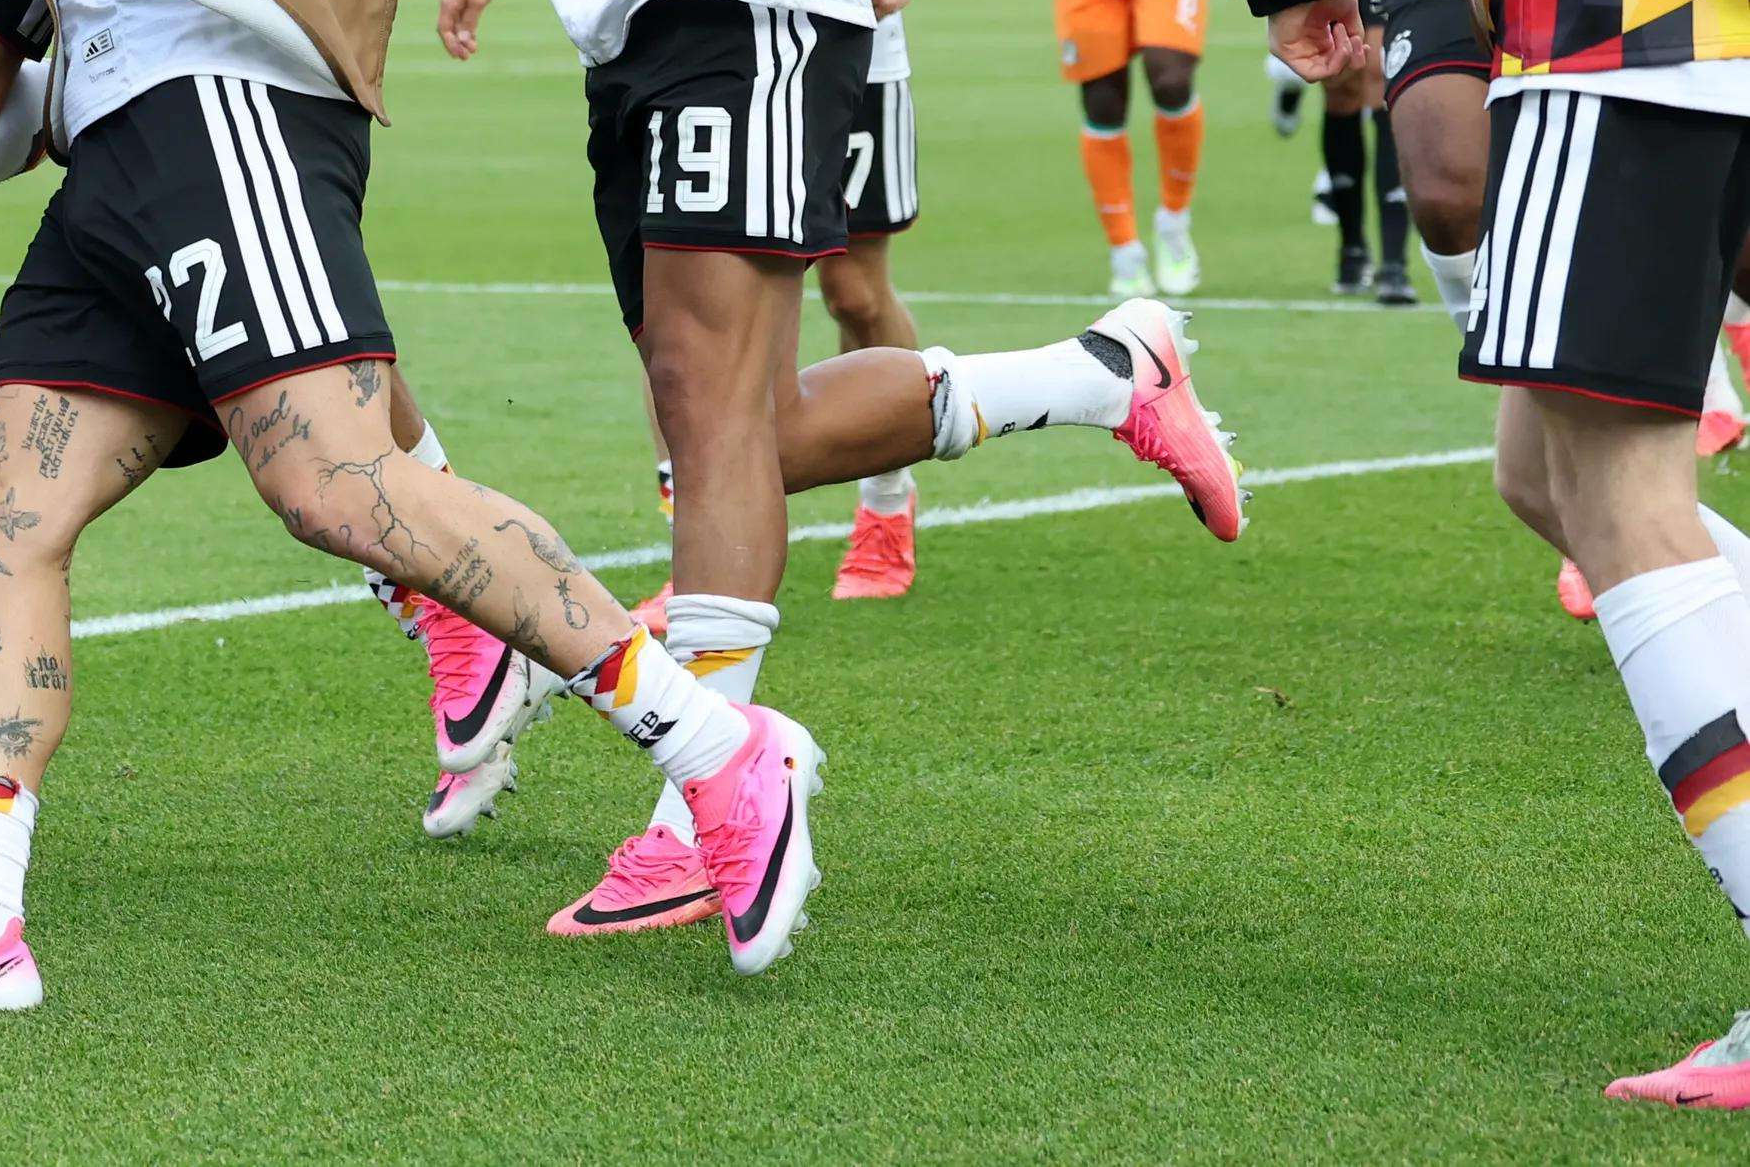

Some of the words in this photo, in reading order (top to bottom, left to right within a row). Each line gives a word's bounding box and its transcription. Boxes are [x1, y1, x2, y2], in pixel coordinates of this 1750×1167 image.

[646, 106, 732, 213] 19
[33, 394, 48, 413] the
[623, 710, 659, 745] FB
